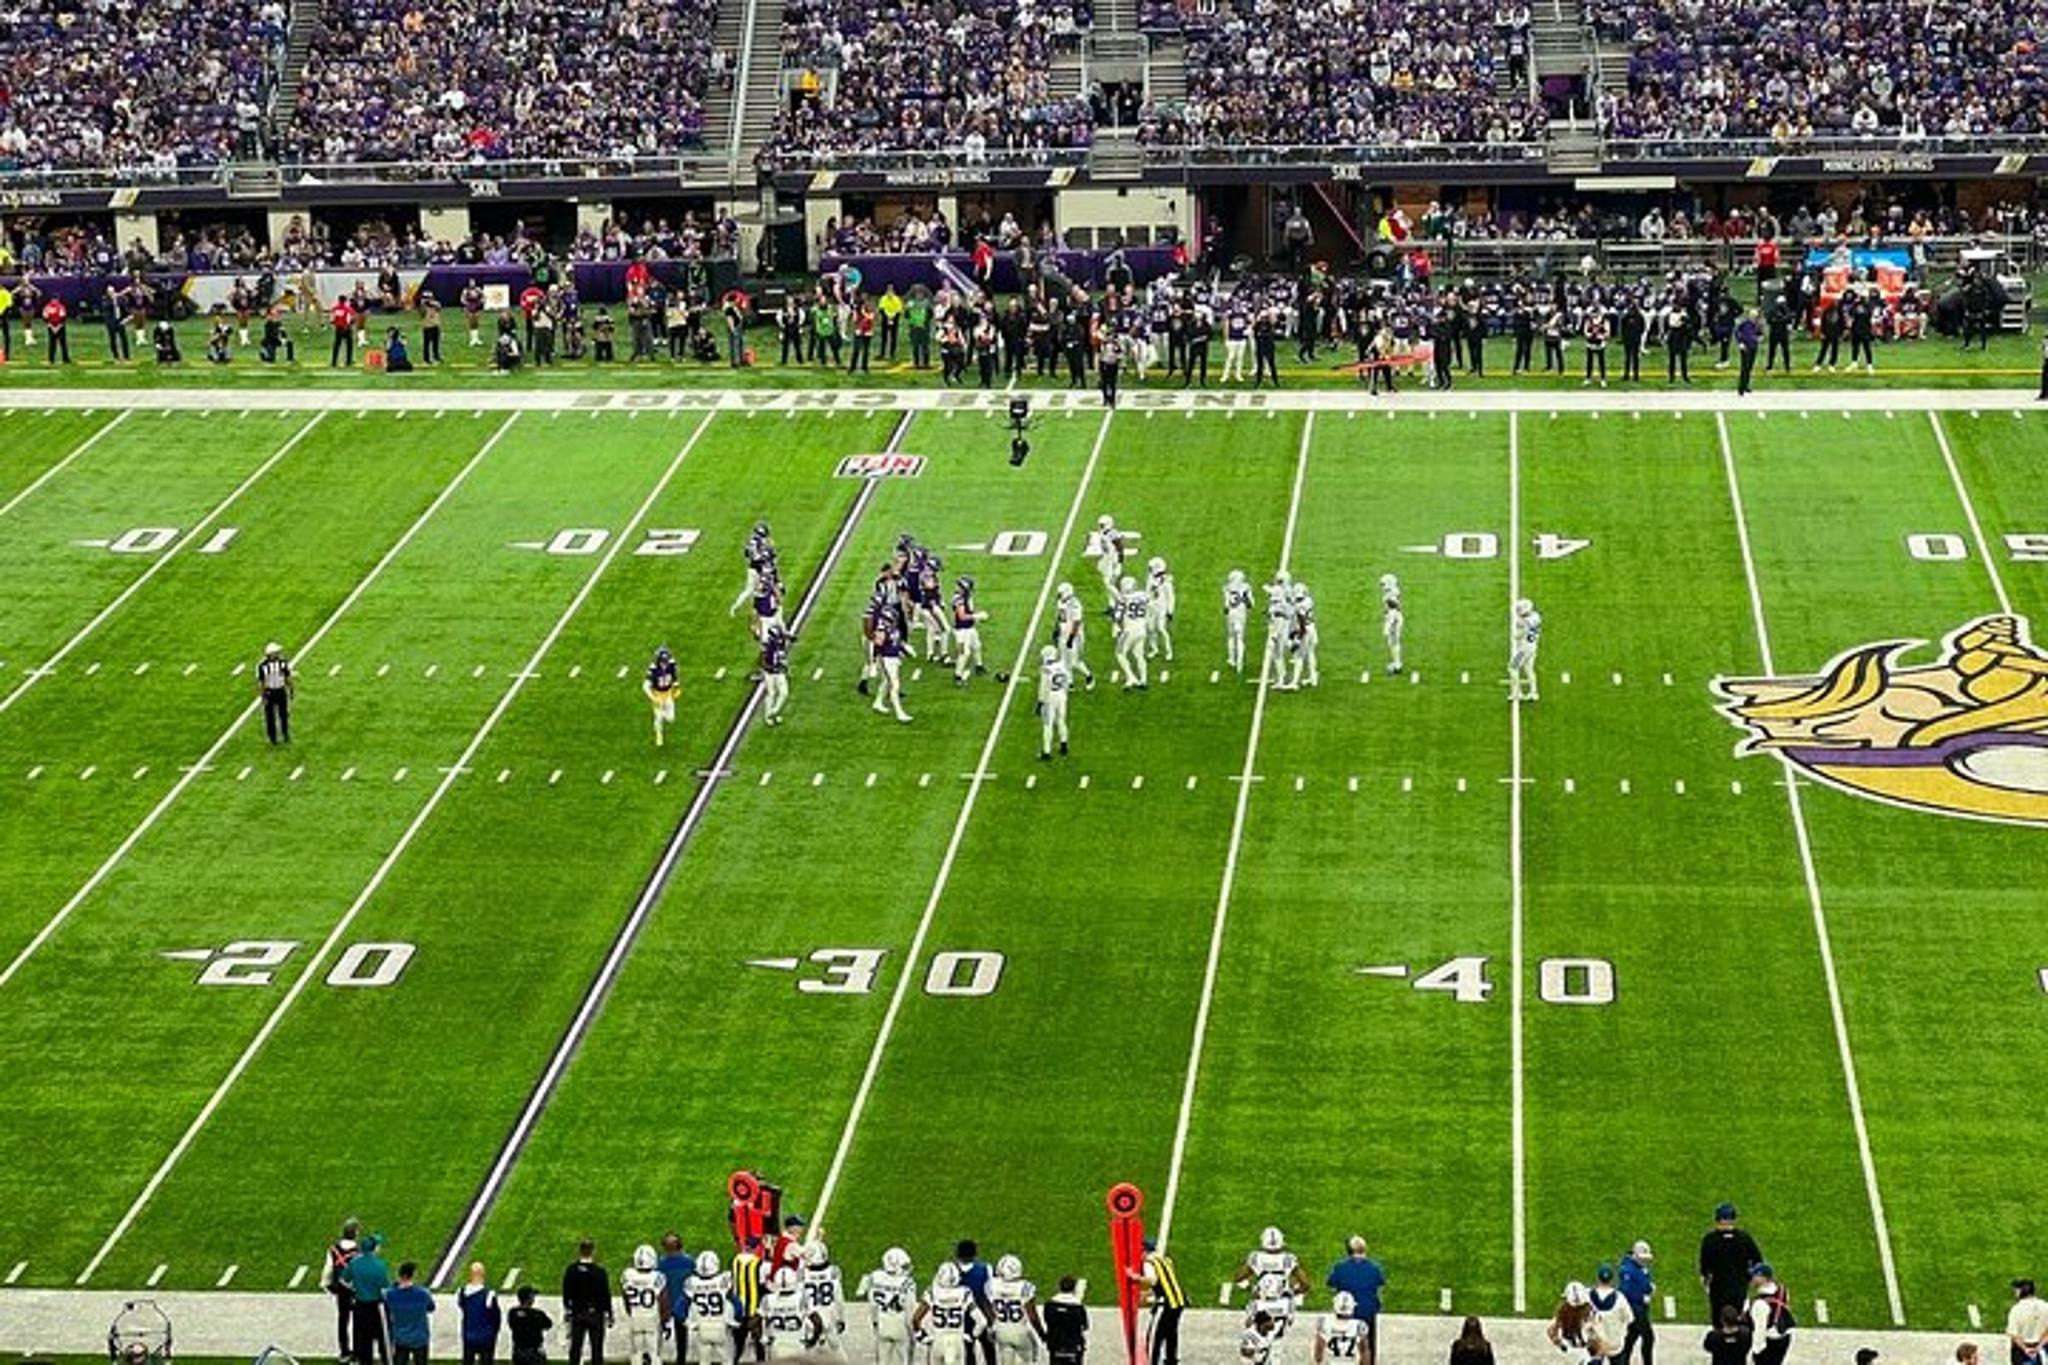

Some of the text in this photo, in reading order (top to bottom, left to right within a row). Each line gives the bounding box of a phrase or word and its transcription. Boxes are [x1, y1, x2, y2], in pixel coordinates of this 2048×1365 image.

[625, 1285, 655, 1308] 20
[694, 1290, 723, 1316] 59
[931, 1305, 963, 1329] 55
[1328, 1335, 1356, 1357] 47
